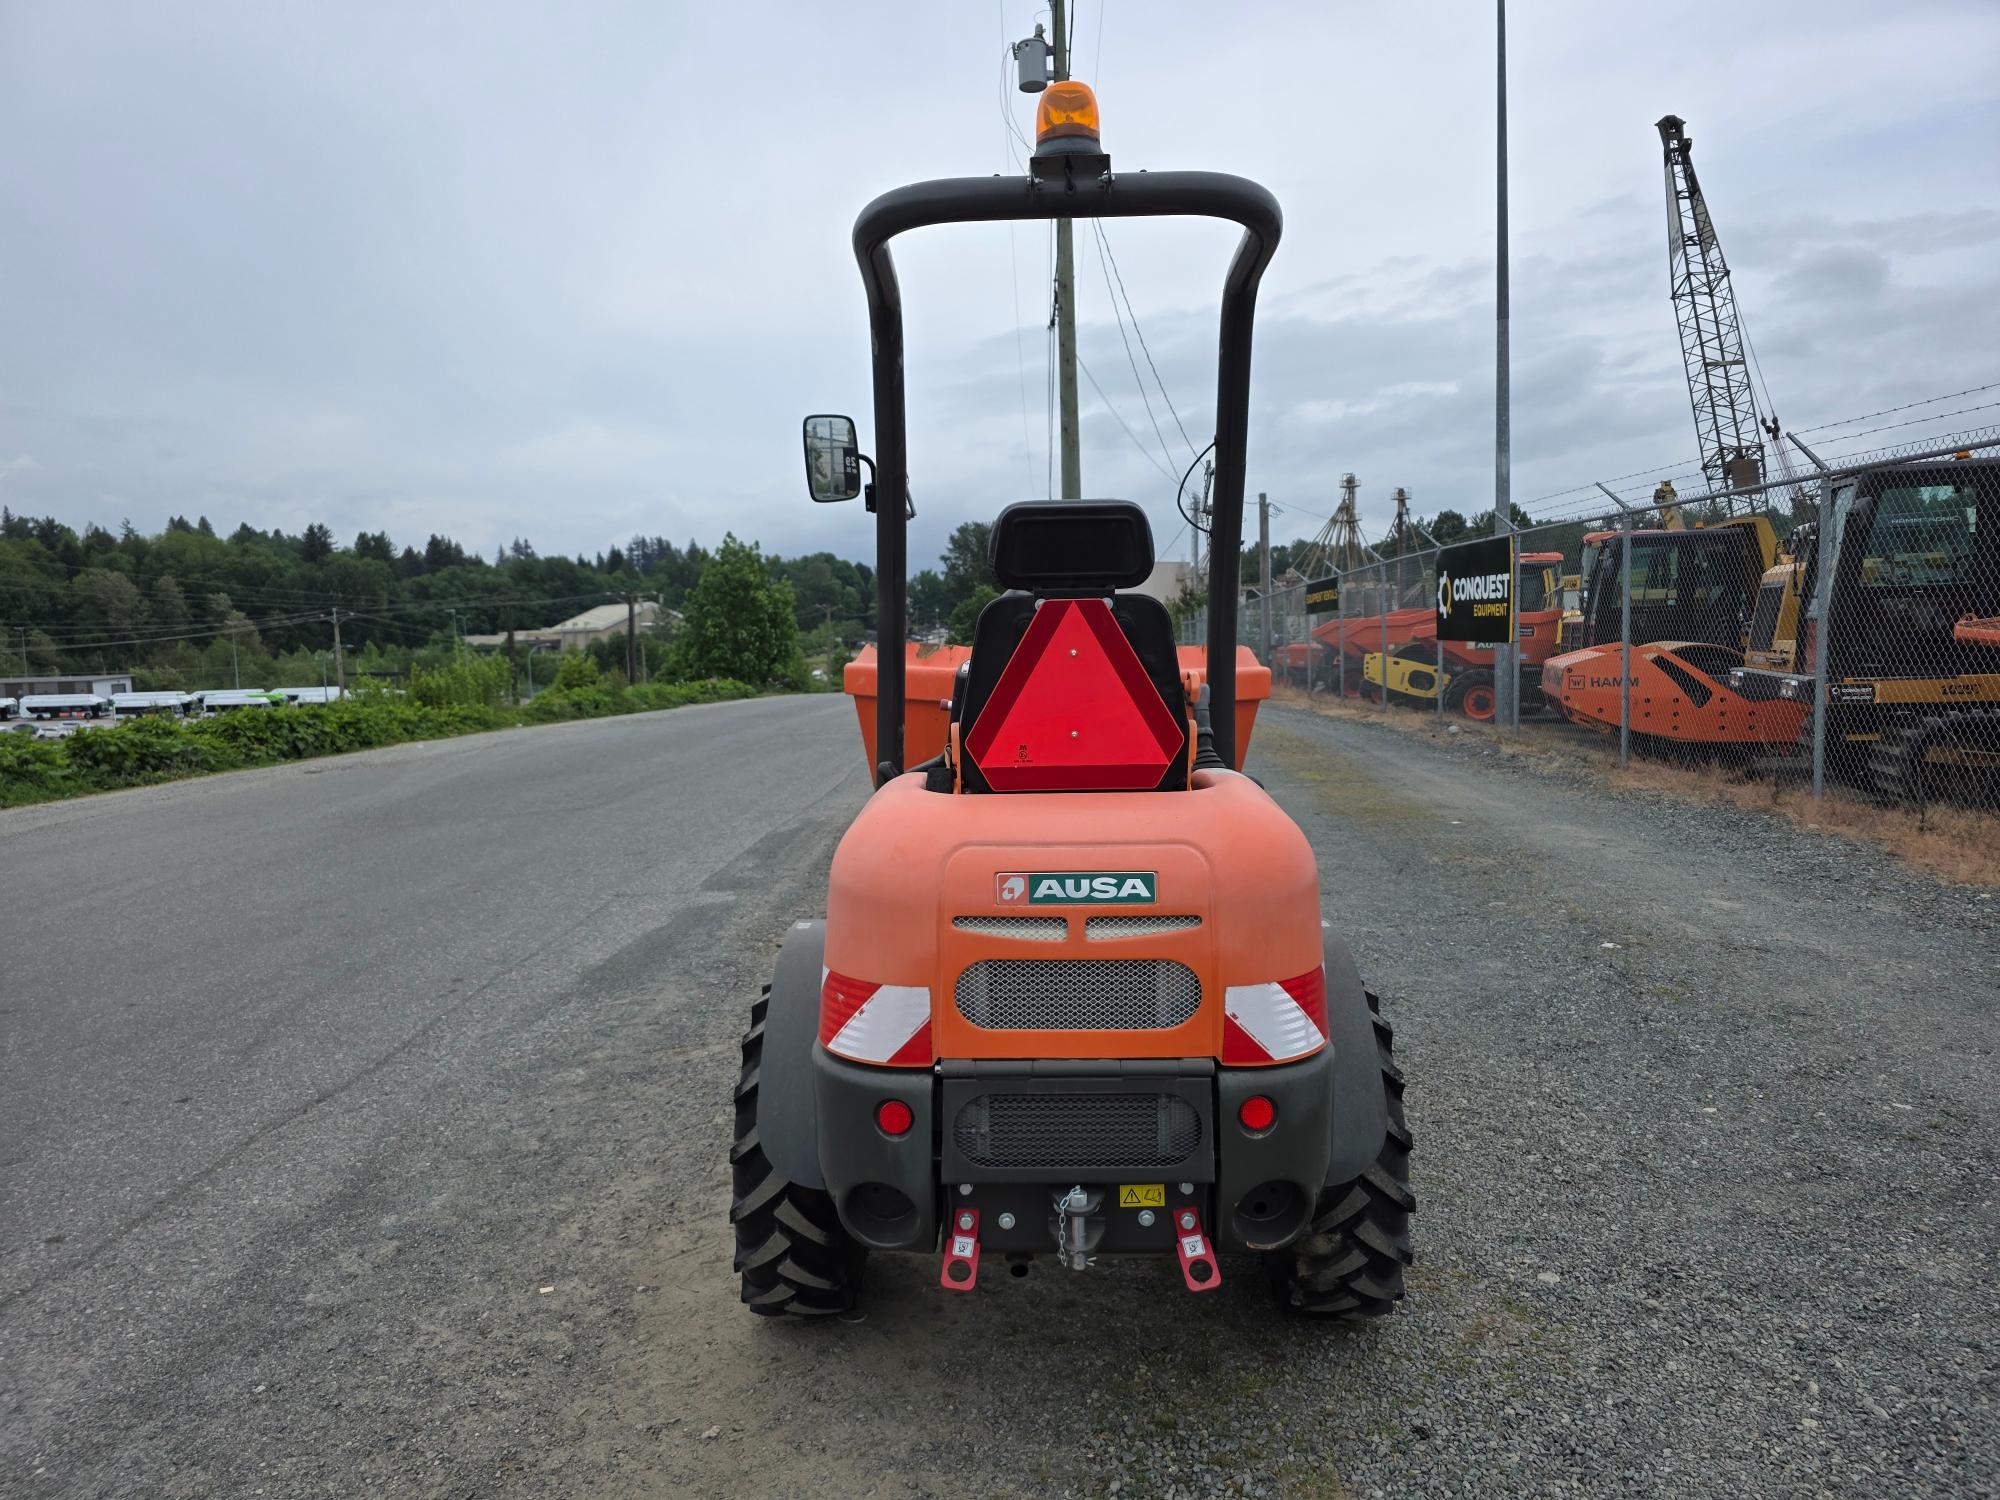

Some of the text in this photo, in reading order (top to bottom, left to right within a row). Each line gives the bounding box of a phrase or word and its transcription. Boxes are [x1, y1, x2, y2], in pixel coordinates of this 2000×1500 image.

[1453, 573, 1510, 601] CONQUEST
[1473, 603, 1508, 617] EQUIPMENT
[1590, 677, 1639, 688] HAMM
[1033, 877, 1152, 899] AUSA
